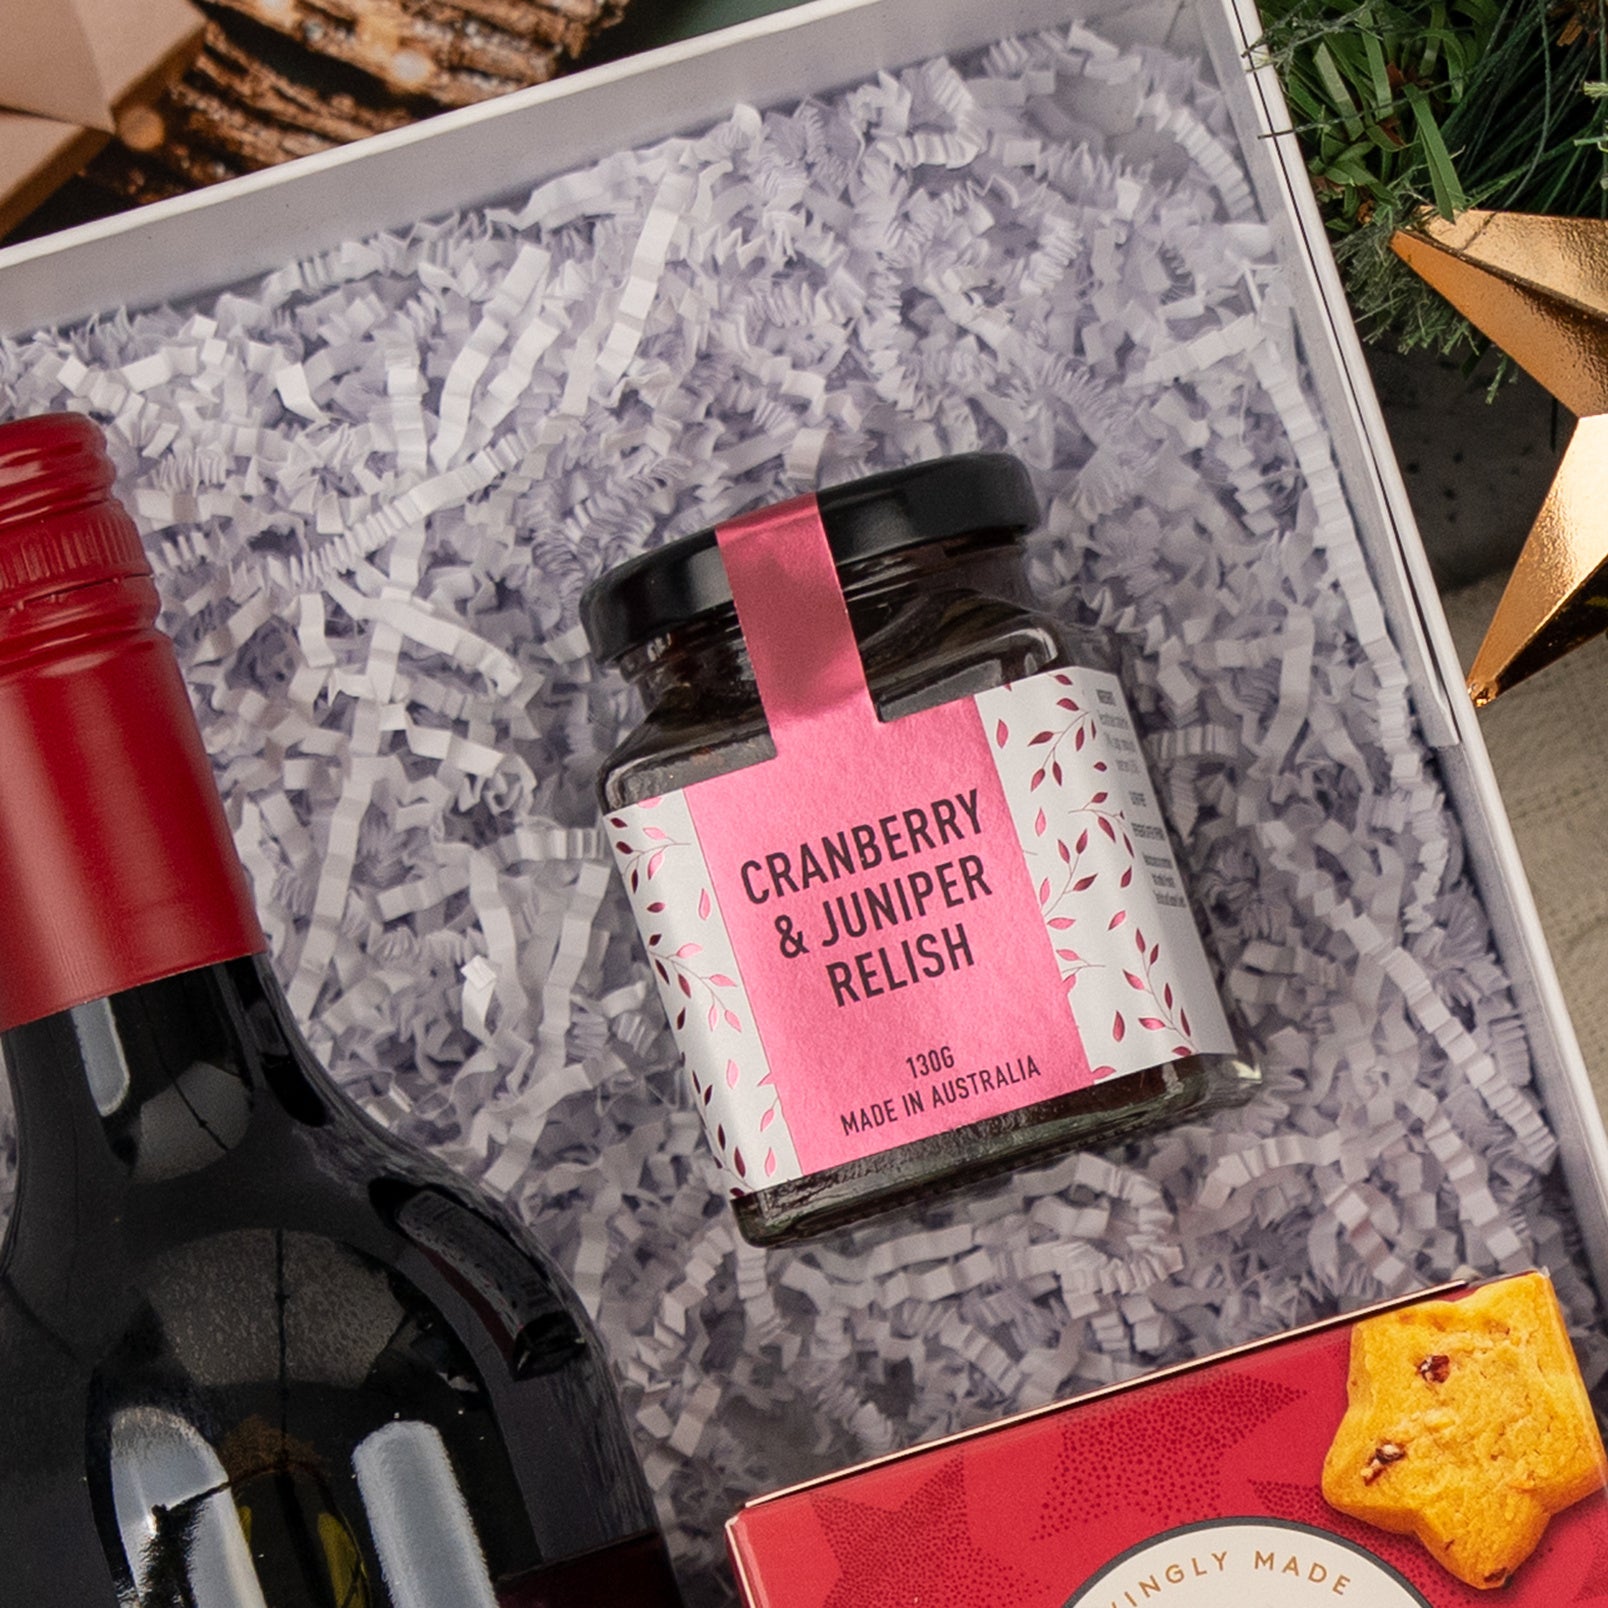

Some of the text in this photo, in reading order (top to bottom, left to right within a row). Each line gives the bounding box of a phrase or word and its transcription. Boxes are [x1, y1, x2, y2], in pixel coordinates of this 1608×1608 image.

[740, 788, 983, 905] CRANBERRY
[774, 854, 993, 959] & JUNIPER
[825, 923, 975, 1008] RELISH
[840, 1055, 1041, 1136] MADE IN AUSTRALIA
[905, 1046, 955, 1079] 130G
[1254, 1550, 1351, 1596] MADE
